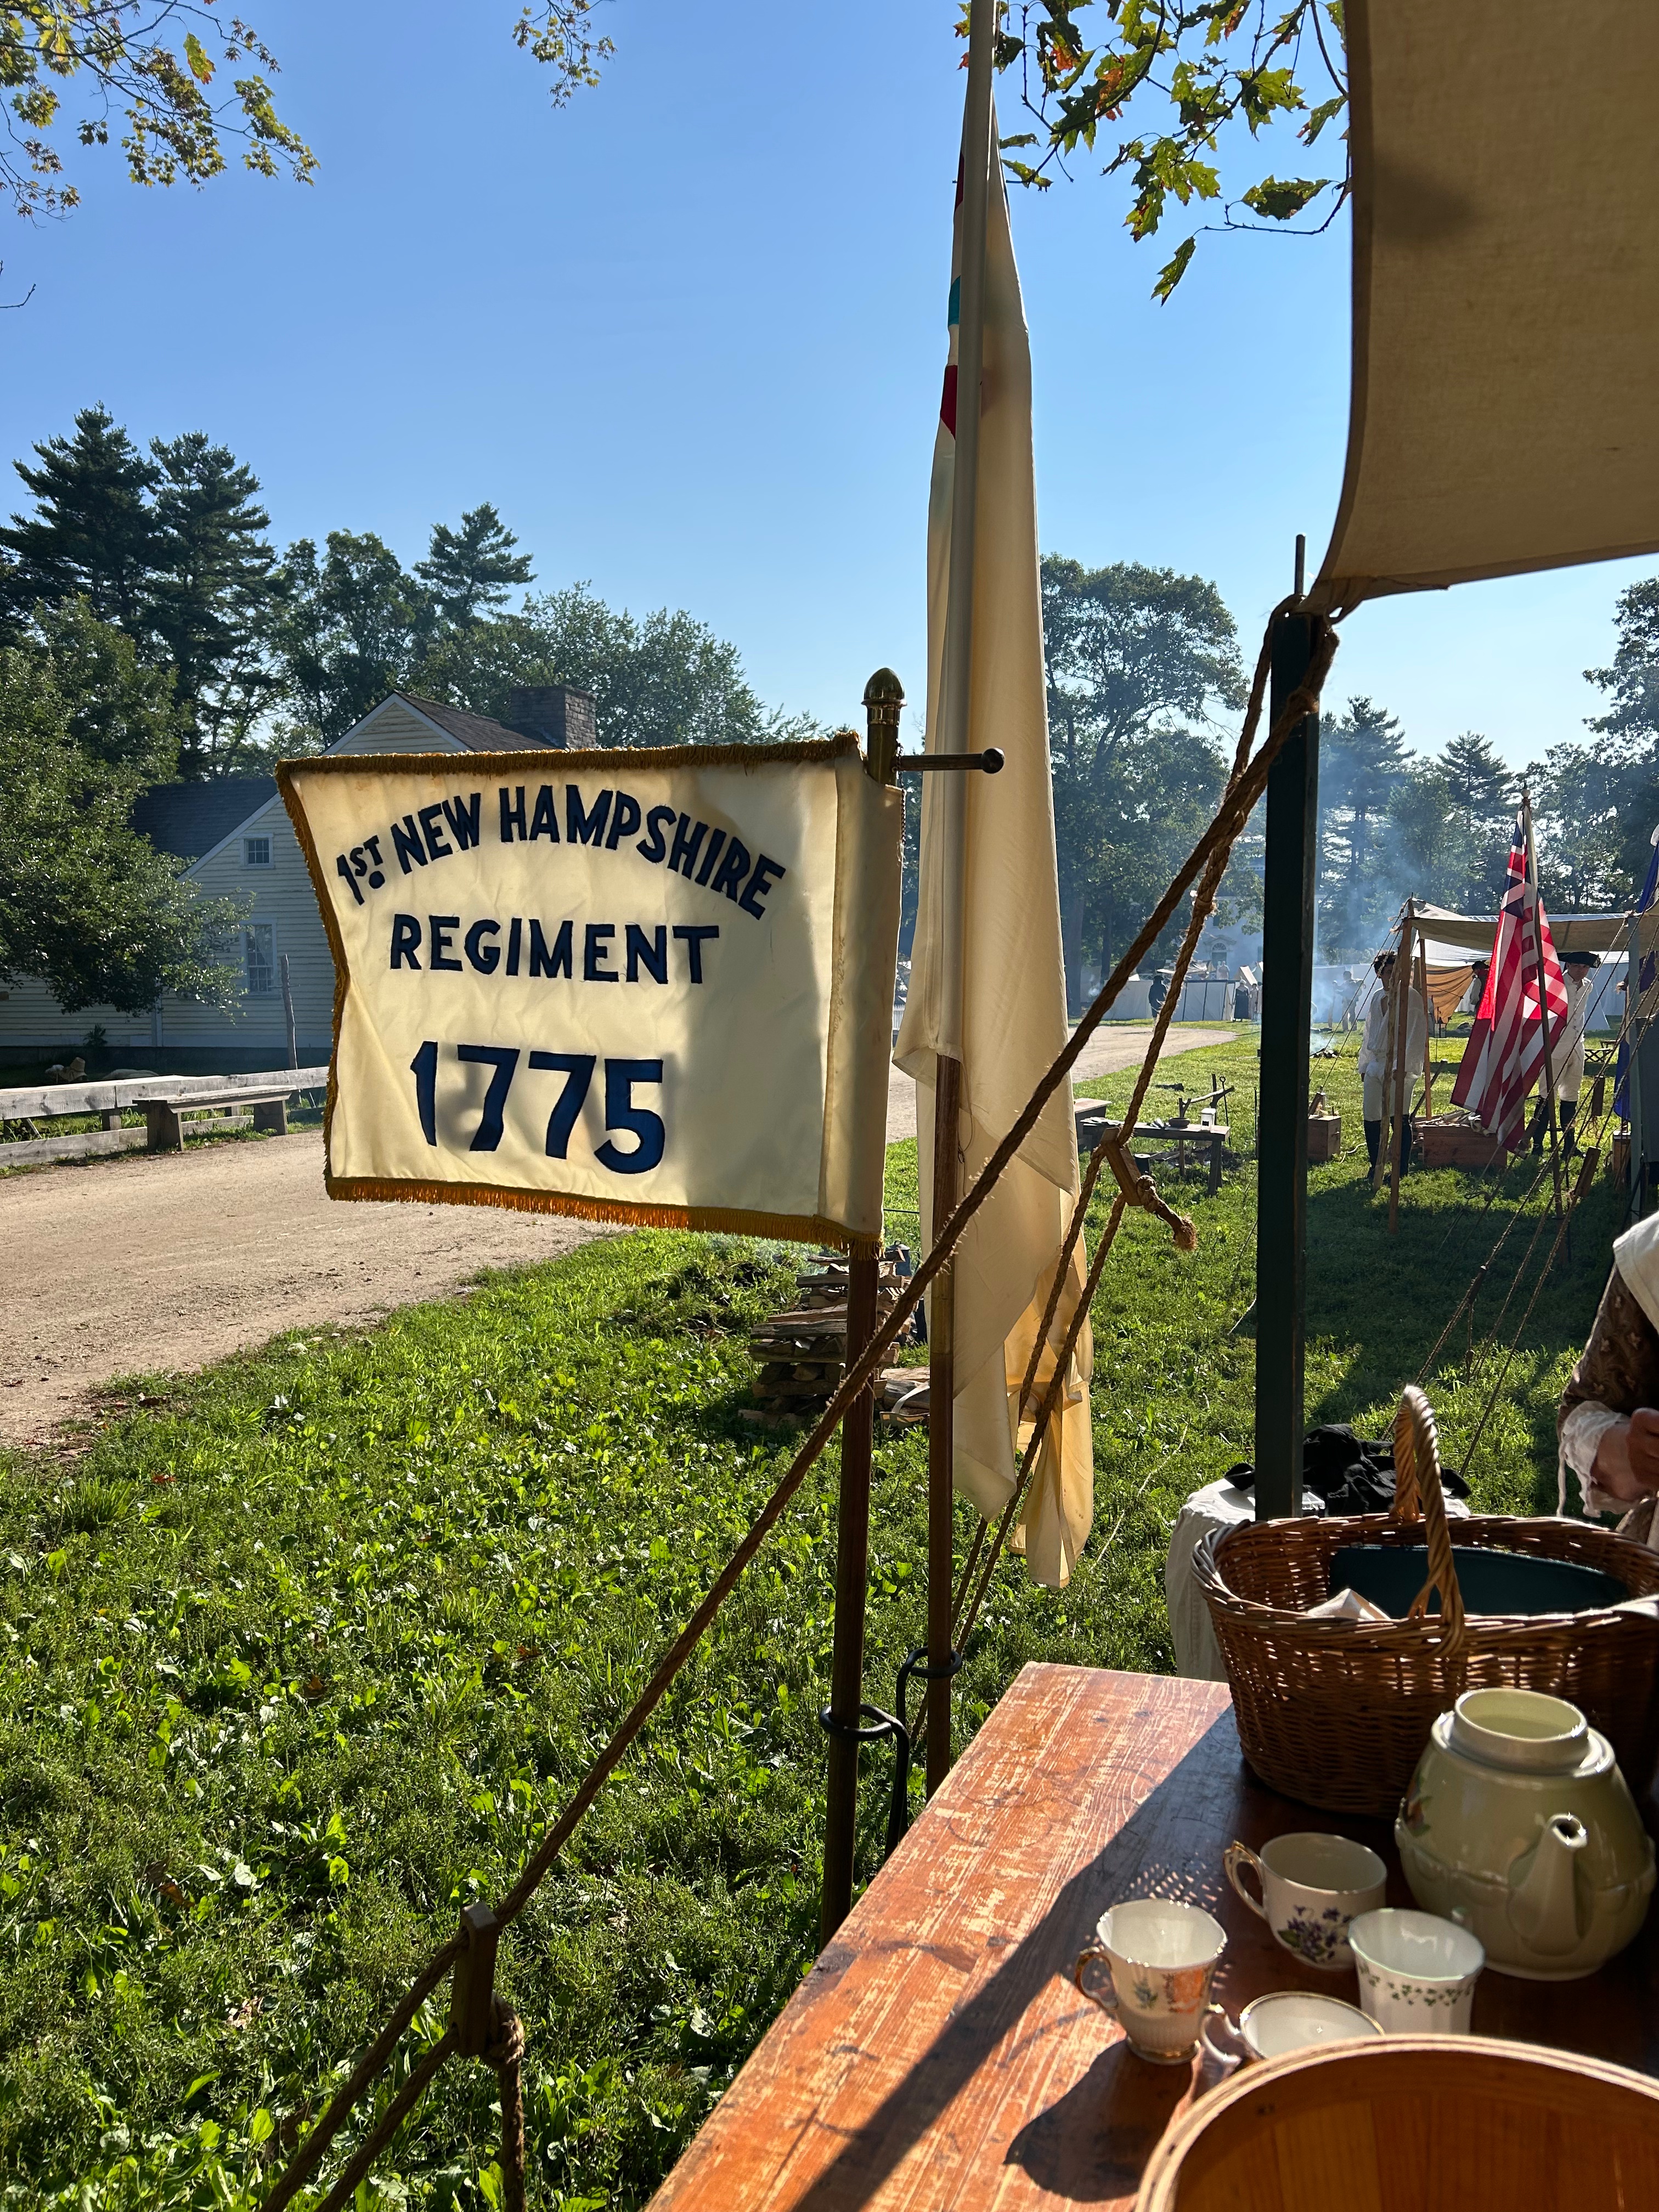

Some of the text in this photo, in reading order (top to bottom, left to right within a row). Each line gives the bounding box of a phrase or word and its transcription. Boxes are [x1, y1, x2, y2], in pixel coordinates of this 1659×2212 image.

[391, 793, 481, 875] NEW
[499, 785, 786, 921] HAMPSHIRE
[390, 913, 719, 984] REGIMENT
[410, 1041, 665, 1174] 1775
